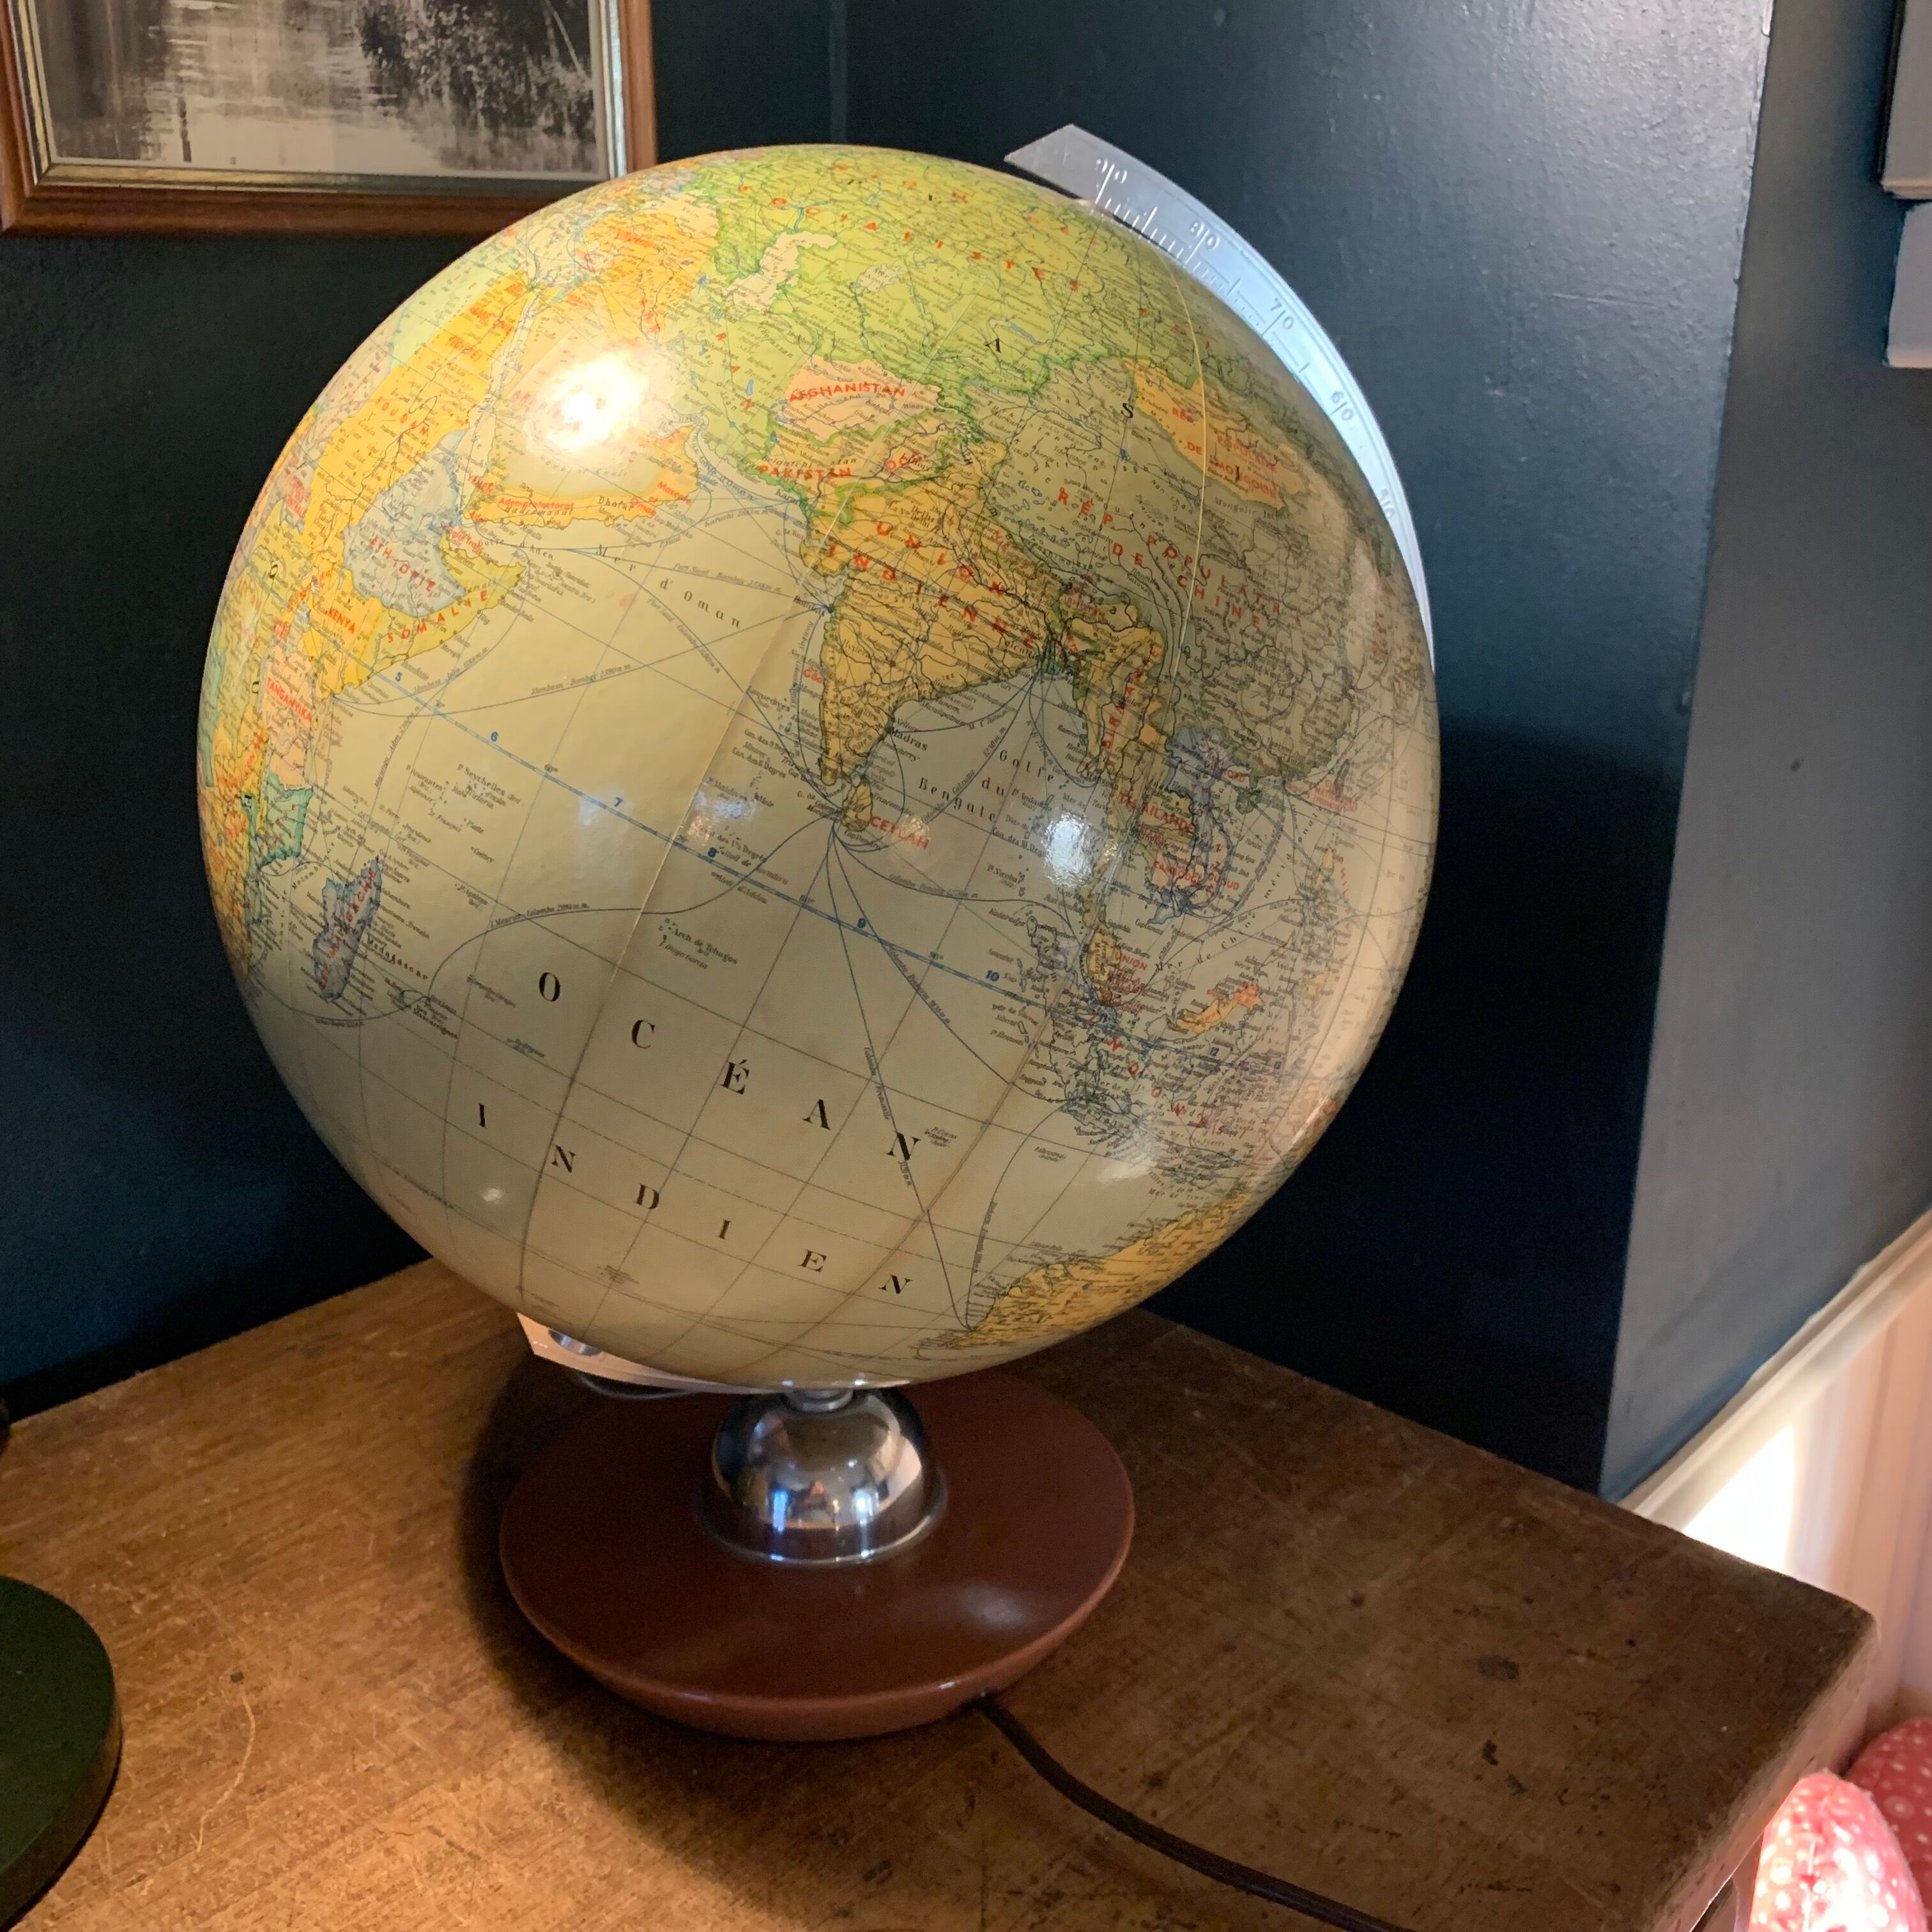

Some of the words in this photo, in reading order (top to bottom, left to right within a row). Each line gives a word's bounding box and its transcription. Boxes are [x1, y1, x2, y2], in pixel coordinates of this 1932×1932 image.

[1269, 297, 1295, 330] 70
[790, 383, 906, 402] AFGHANISTAN
[1330, 390, 1355, 422] 60
[1186, 441, 1202, 455] DE
[1112, 542, 1144, 565] DE
[595, 544, 636, 572] Mer
[683, 590, 740, 629] Oman
[326, 607, 356, 634] KENYA
[395, 672, 402, 681] 5
[266, 675, 312, 723] TANGANYIKA
[491, 732, 499, 742] 6
[887, 727, 928, 751] Madras
[999, 749, 1054, 783] Golfe
[465, 767, 505, 797] Seychelles
[981, 778, 1008, 798] du
[613, 796, 624, 808] 7
[917, 777, 996, 823] Bengale
[1222, 877, 1240, 890] SUD
[1115, 952, 1149, 970] UNION
[1197, 953, 1211, 965] de
[986, 969, 1000, 982] 10
[538, 971, 923, 1163] OCÉAN
[477, 1103, 914, 1296] INDIEN
